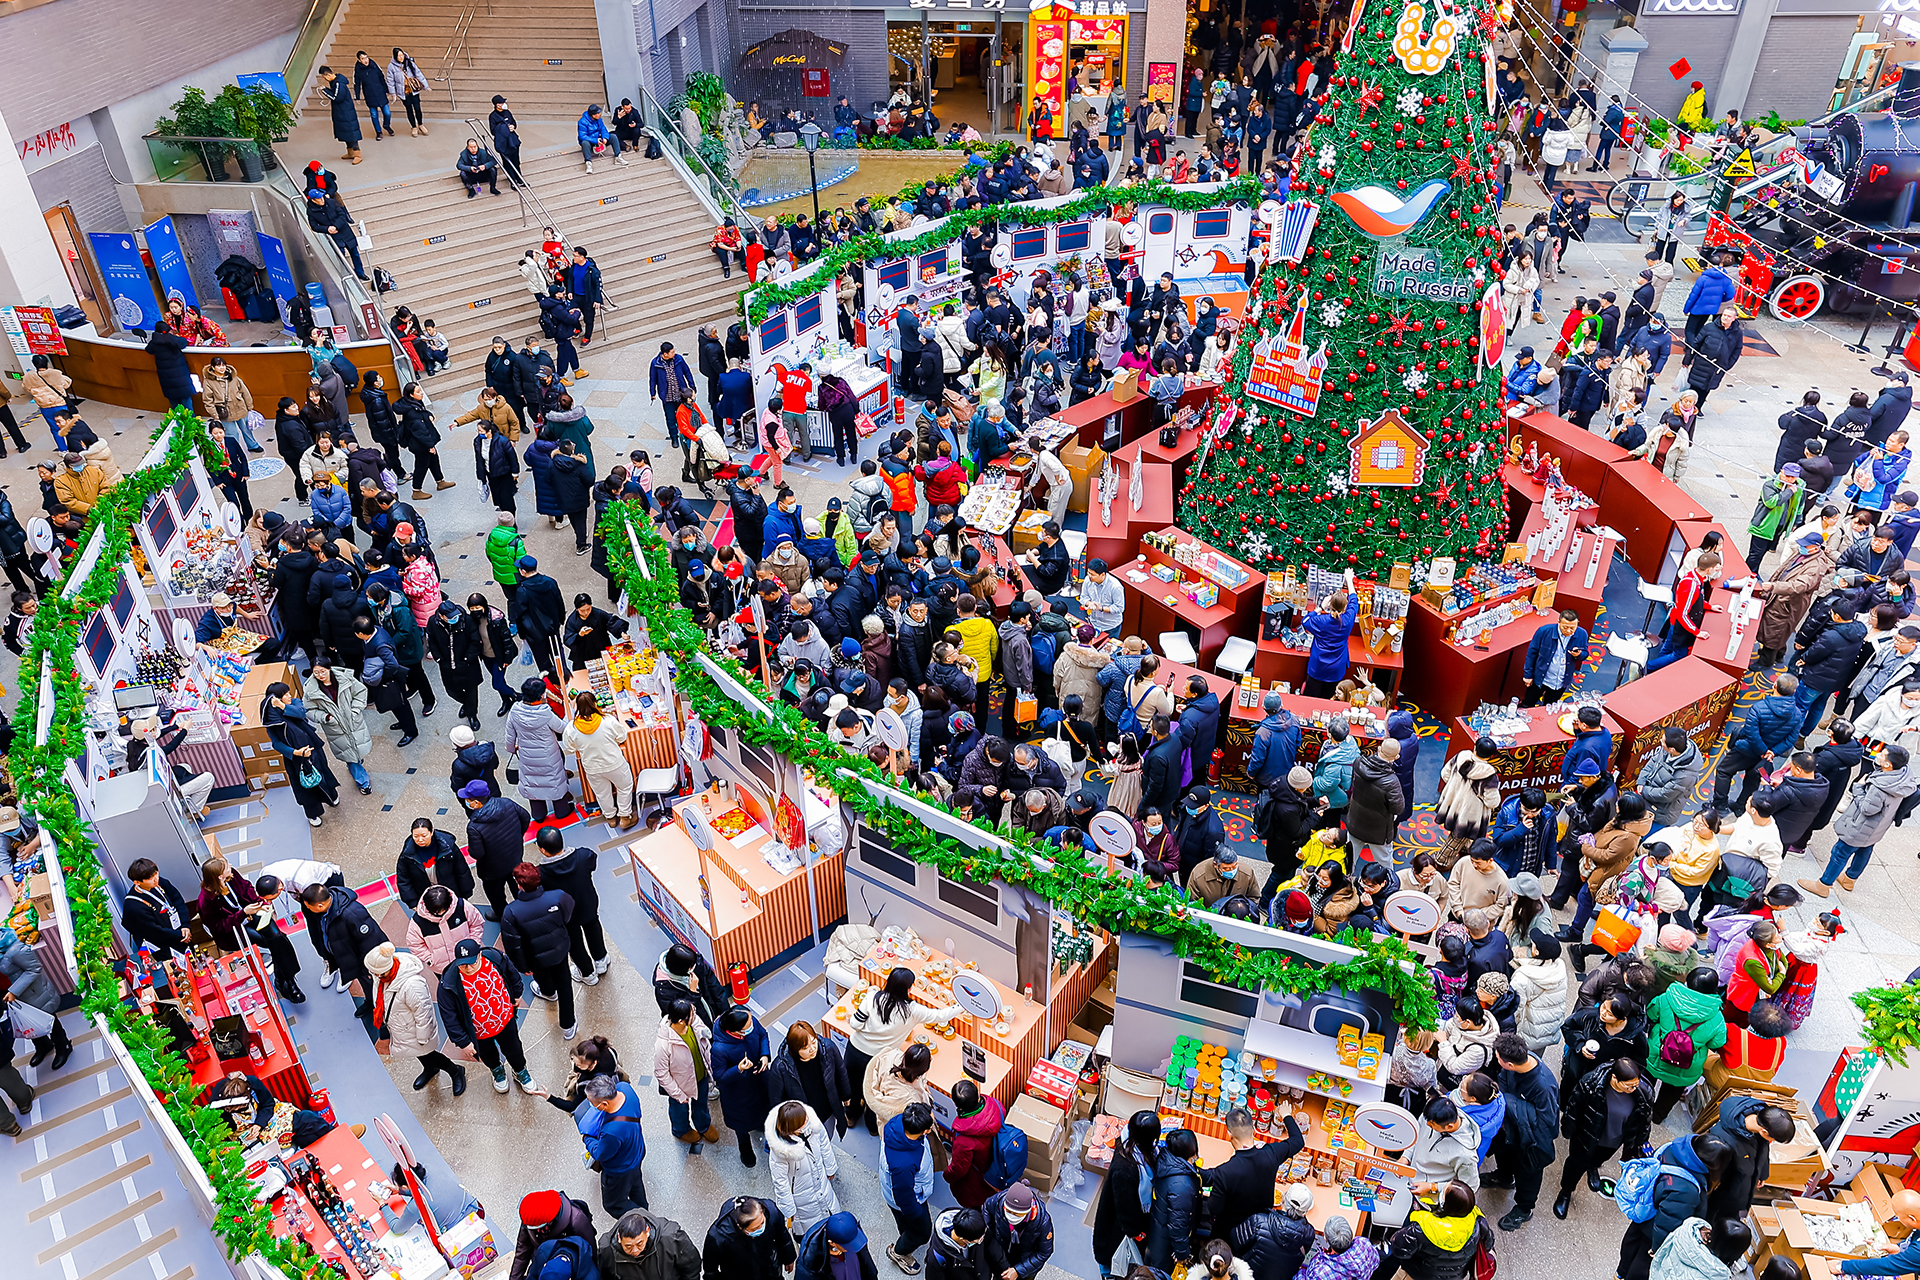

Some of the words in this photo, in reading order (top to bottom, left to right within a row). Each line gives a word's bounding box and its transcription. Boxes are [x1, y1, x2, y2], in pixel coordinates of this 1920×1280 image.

[1080, 0, 1128, 16] 甜品站
[1381, 251, 1436, 273] Made
[1377, 275, 1396, 293] in
[1402, 277, 1469, 299] Russia
[786, 374, 806, 387] SPLAT
[1639, 745, 1661, 763] MAD
[1687, 720, 1711, 738] USSIA
[1498, 778, 1529, 790] ADE
[1531, 776, 1546, 787] IN
[1366, 1157, 1399, 1171] KORNER
